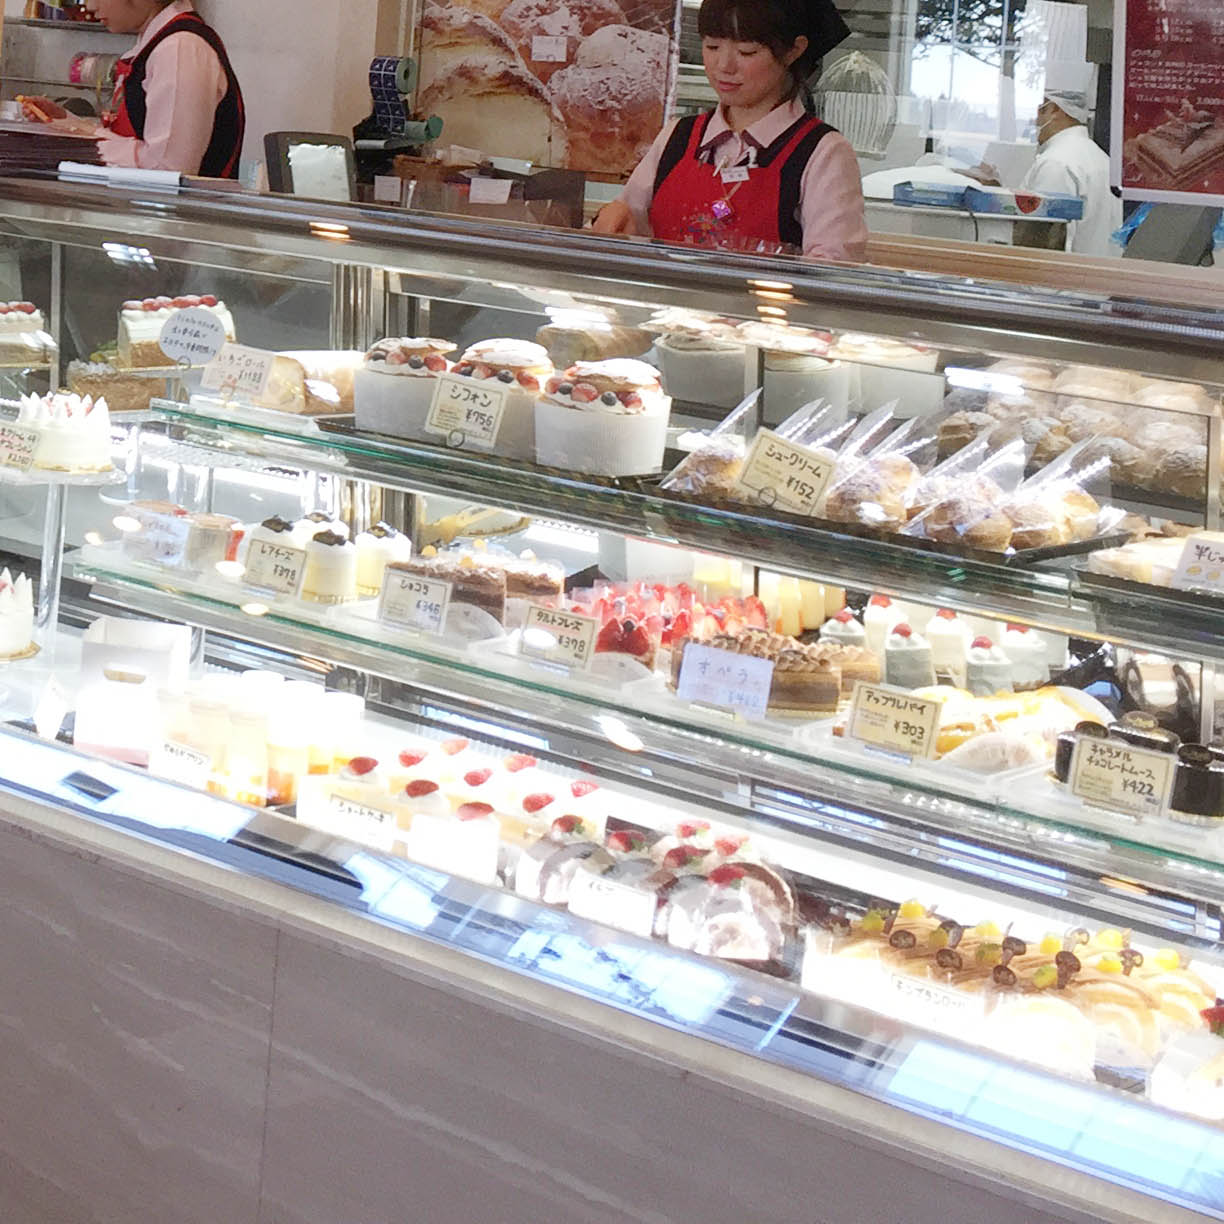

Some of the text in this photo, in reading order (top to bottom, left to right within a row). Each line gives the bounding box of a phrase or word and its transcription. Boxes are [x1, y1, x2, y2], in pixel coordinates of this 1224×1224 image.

[449, 383, 493, 408] シフォン
[464, 408, 494, 428] ¥756
[764, 442, 822, 480] シュークリーム
[785, 474, 817, 501] ¥152
[399, 578, 431, 597] ショコラ
[557, 634, 587, 655] ¥378
[864, 690, 928, 716] アップルパイ
[893, 719, 927, 740] ¥303
[1091, 743, 1133, 763] キャラメル
[1085, 756, 1156, 781] チョコレートムース
[1120, 777, 1156, 798] ¥422
